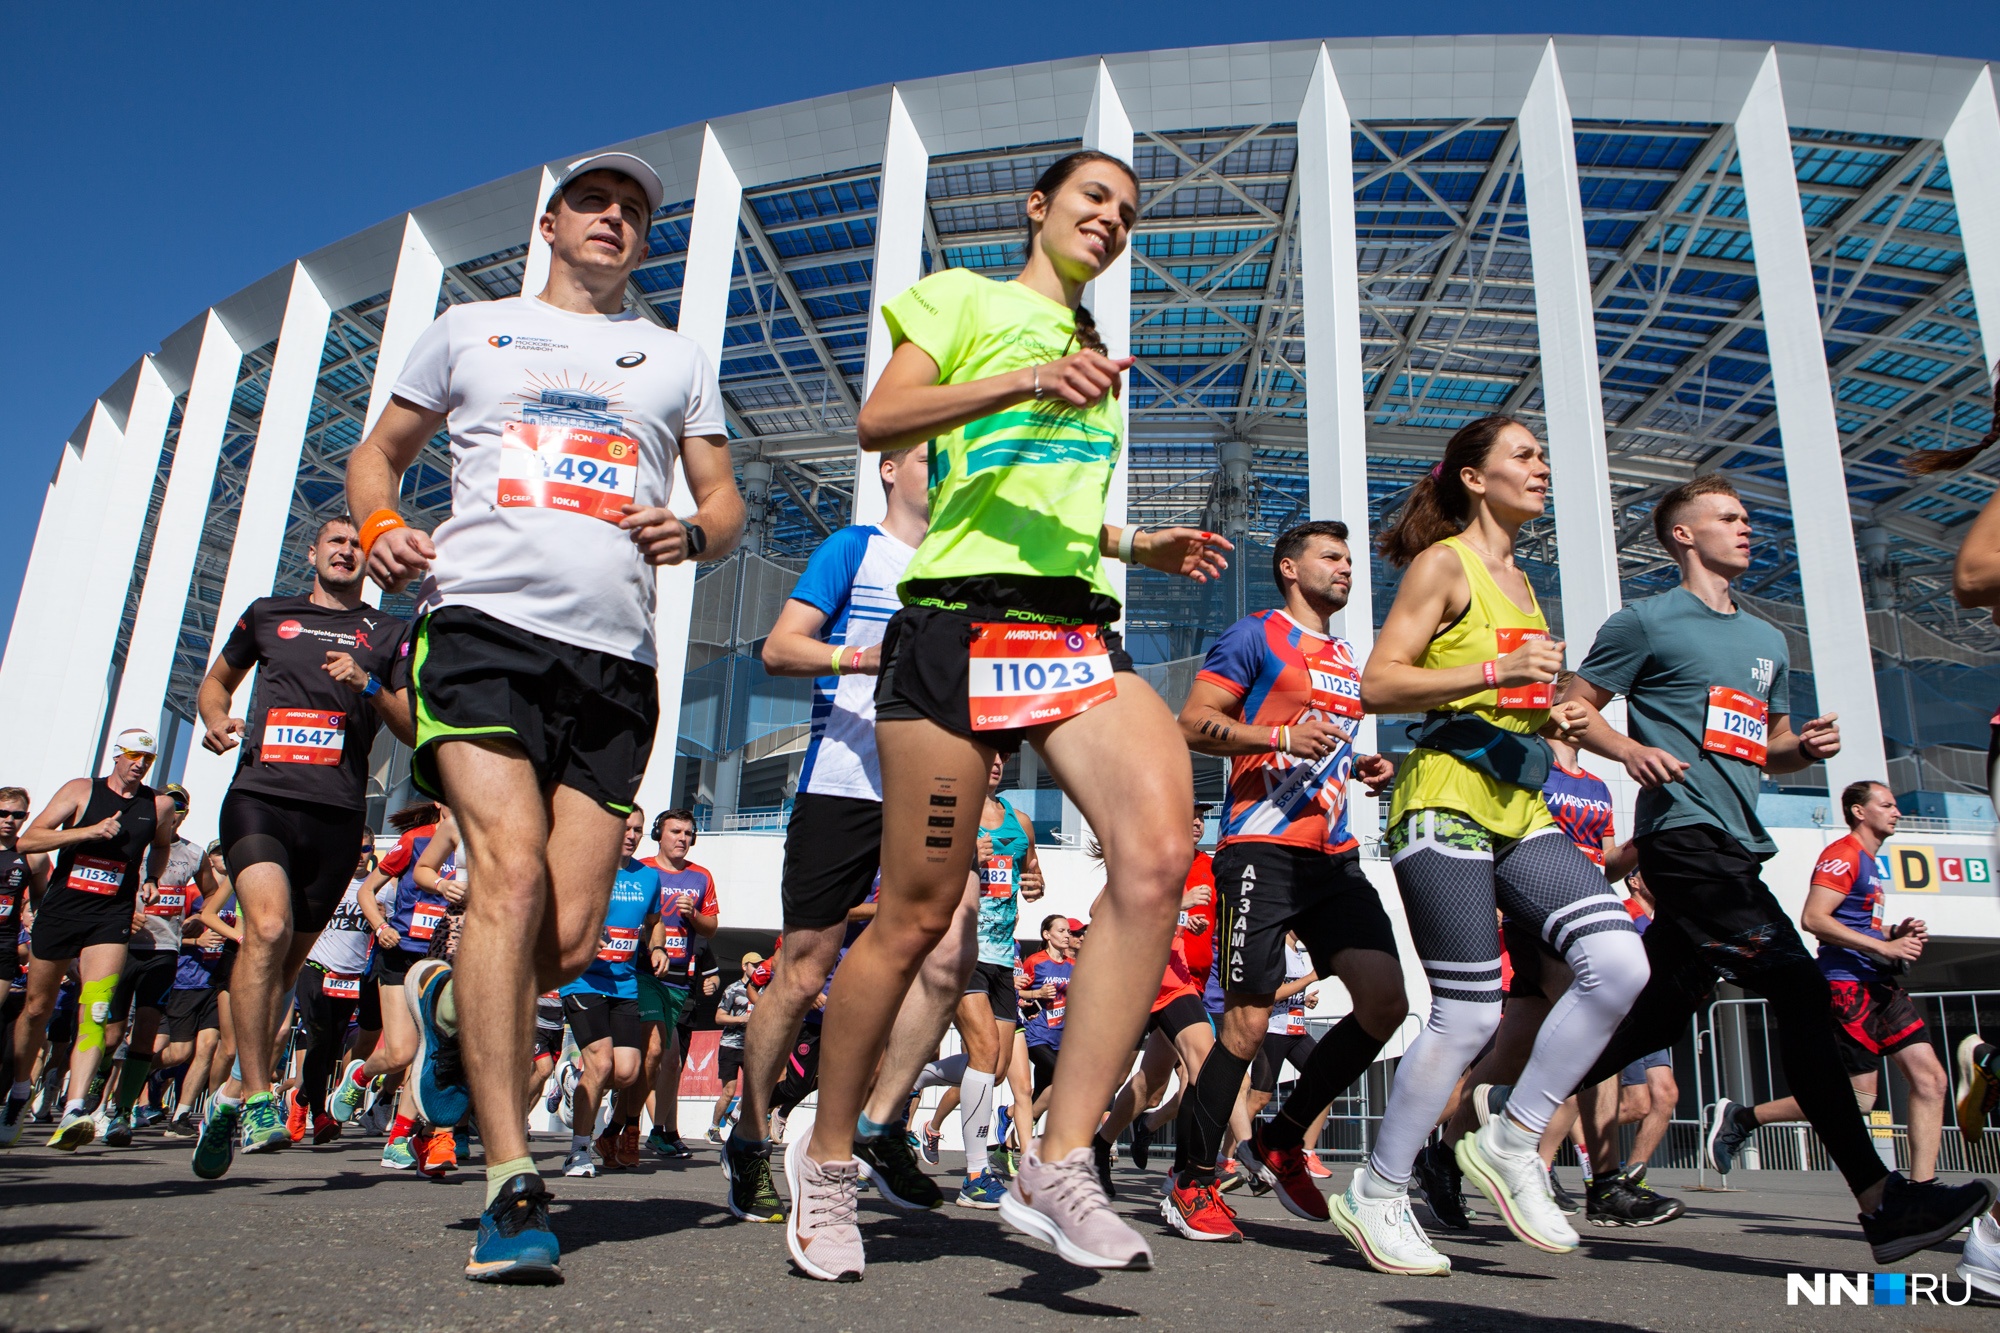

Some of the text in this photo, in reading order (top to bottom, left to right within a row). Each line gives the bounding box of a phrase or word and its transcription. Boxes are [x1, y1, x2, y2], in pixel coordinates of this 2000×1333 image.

[910, 286, 938, 316] HUAWEI
[515, 340, 569, 349] МОСКОВСКИЙ
[612, 444, 623, 456] B
[909, 596, 968, 611] OWERUP
[1004, 609, 1083, 626] POWERUP
[337, 638, 355, 646] Bonn
[1004, 630, 1057, 641] MARATHON
[992, 661, 1095, 691] 11023
[1320, 673, 1360, 698] 11255
[987, 715, 1008, 723] СБЕР
[1724, 712, 1763, 740] 12199
[277, 728, 337, 746] 11647
[79, 867, 118, 883] 11528
[1899, 850, 1930, 889] D
[1943, 859, 1960, 881] C
[1968, 860, 1986, 881] B
[1231, 864, 1257, 982] АРЗАМАС
